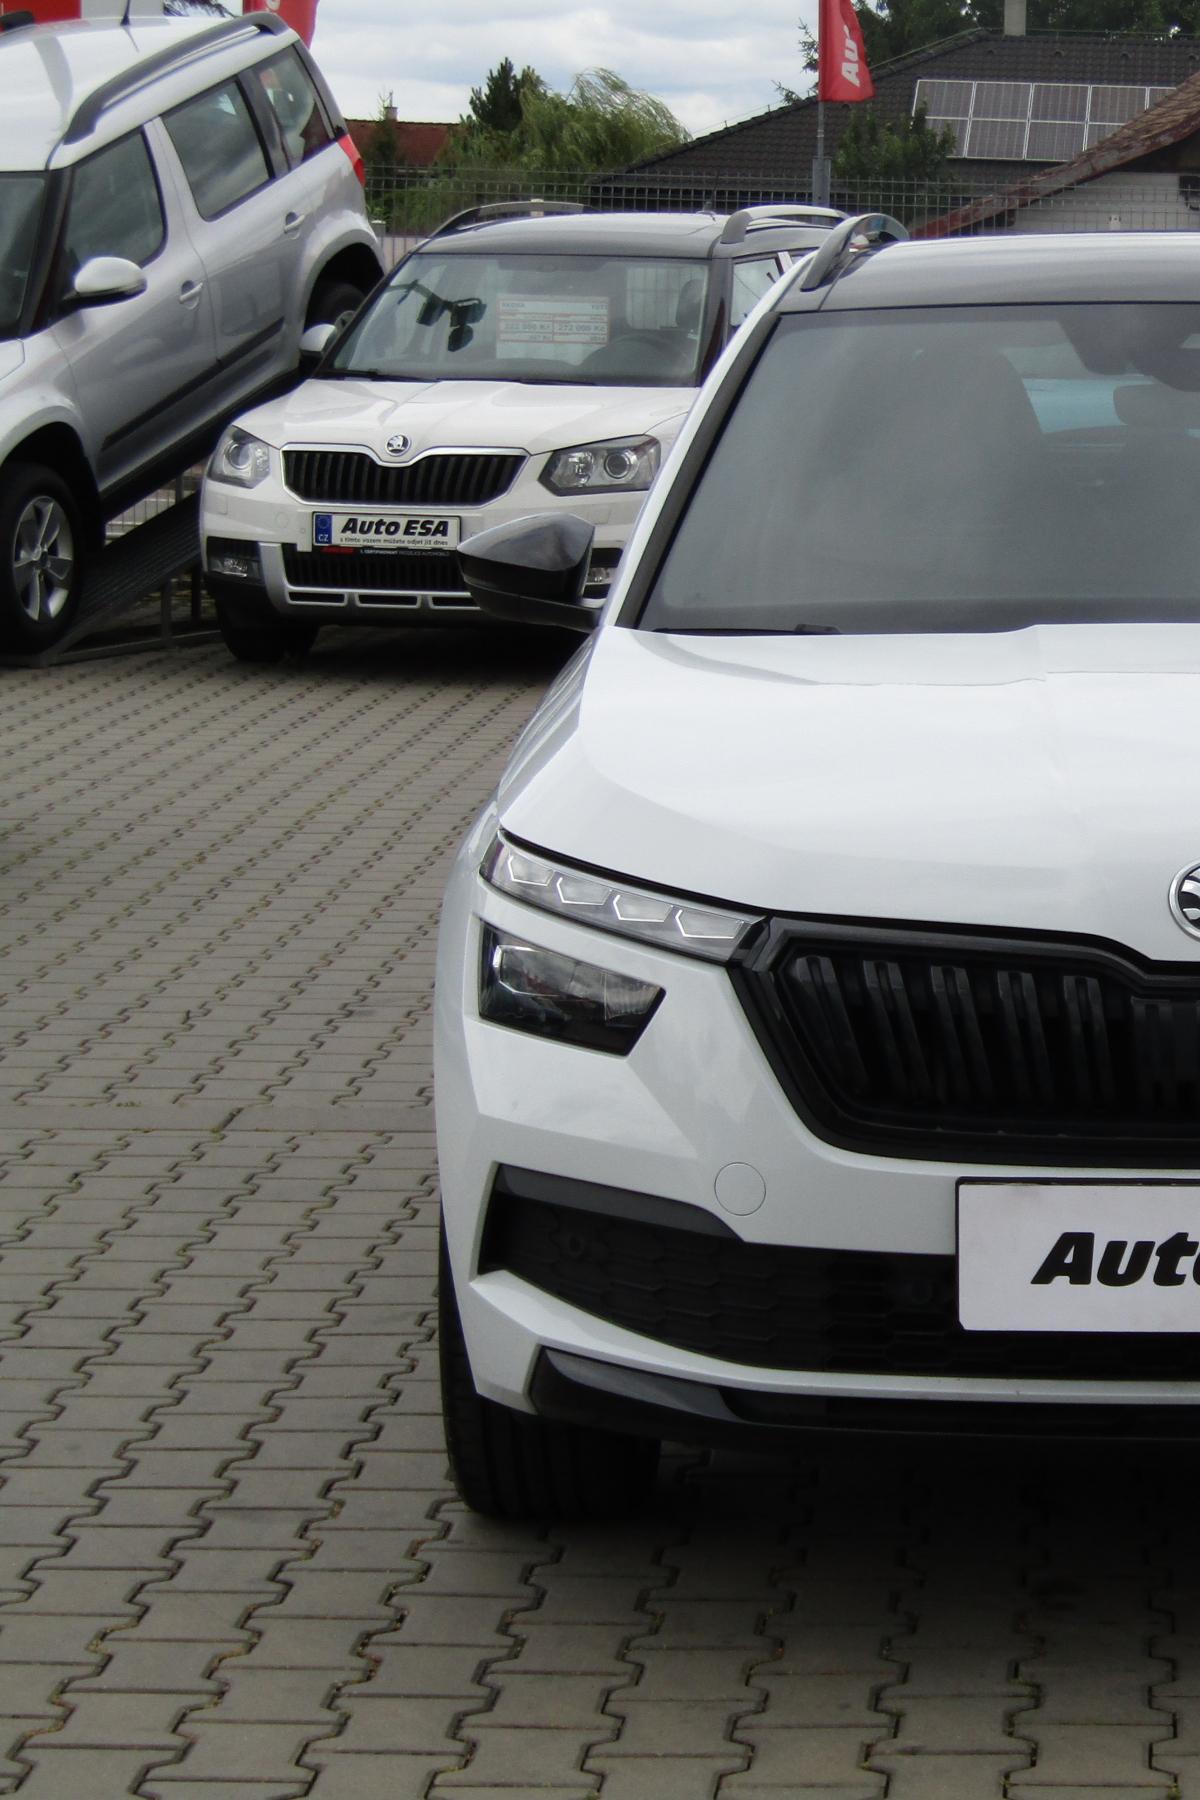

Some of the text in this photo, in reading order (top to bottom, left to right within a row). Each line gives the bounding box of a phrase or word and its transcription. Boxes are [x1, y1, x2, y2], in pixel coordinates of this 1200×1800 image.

[841, 25, 860, 87] Au
[341, 518, 449, 537] Auto ESA
[318, 534, 329, 542] CZ
